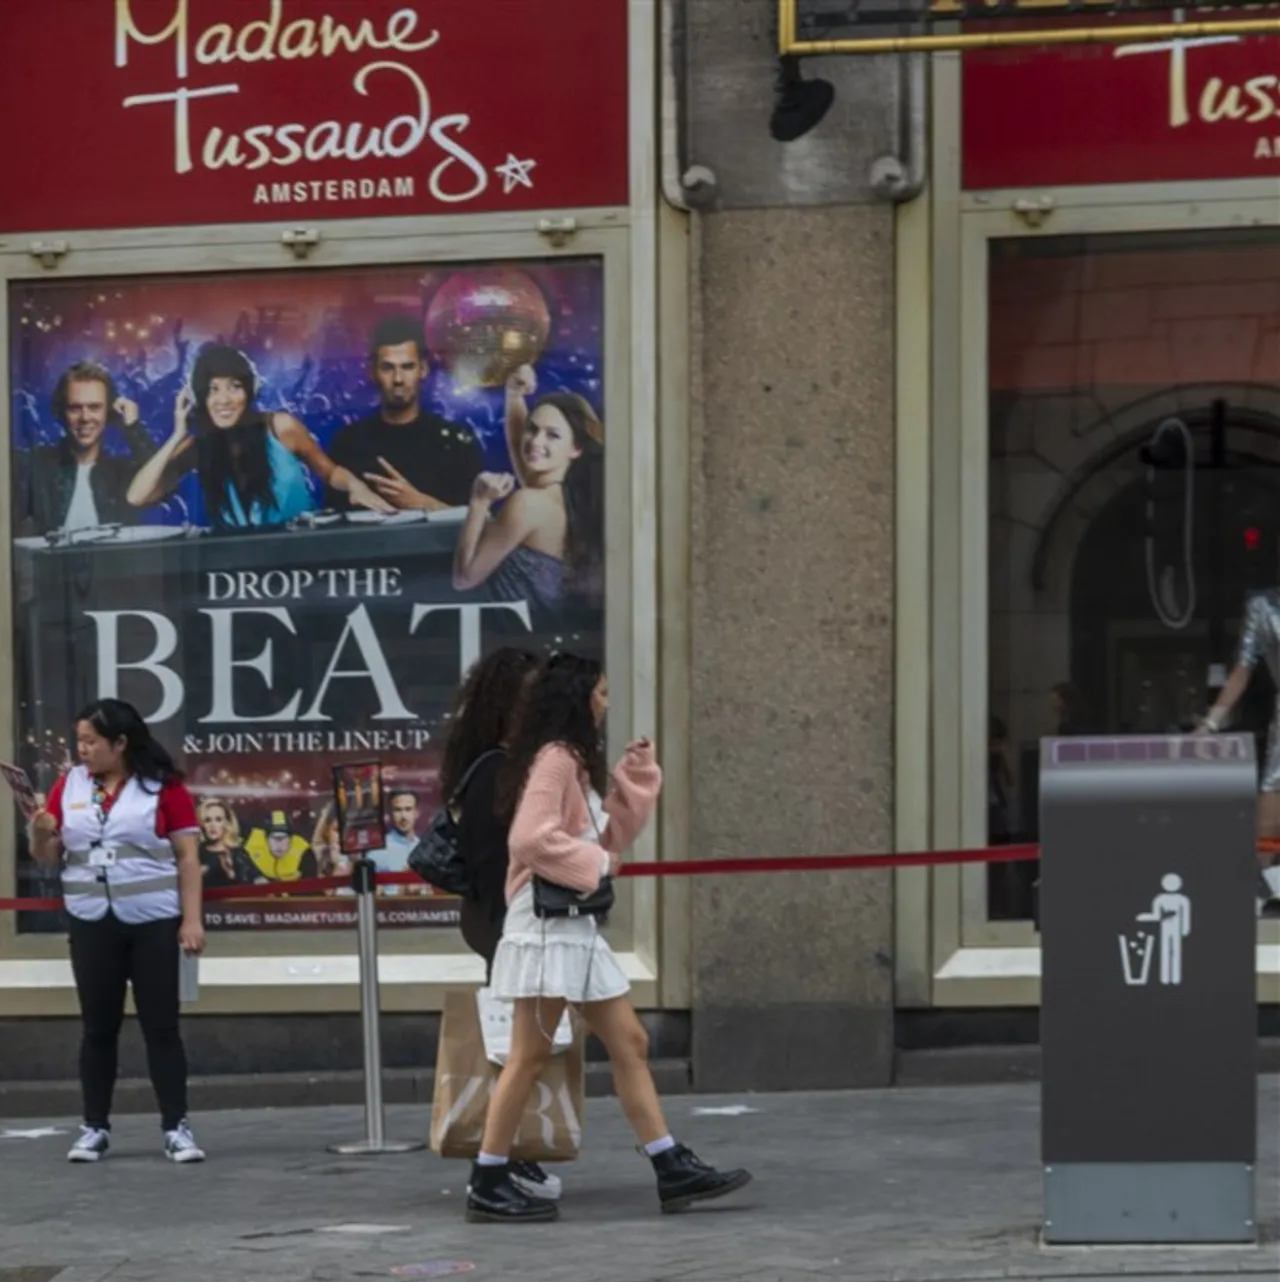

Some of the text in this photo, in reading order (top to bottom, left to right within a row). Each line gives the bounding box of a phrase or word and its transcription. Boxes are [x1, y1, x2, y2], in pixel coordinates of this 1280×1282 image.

[114, 0, 440, 79] Madame
[1113, 35, 1280, 127] Tus
[122, 61, 489, 202] Tussauds
[253, 176, 414, 204] AMSTERDAM
[207, 567, 403, 601] DROP THE
[83, 601, 532, 724] BEAT
[183, 729, 431, 754] & JOIN THE LINE-UP
[205, 908, 461, 926] TO SAVE: MADAMETUSSAS.COM/AMST
